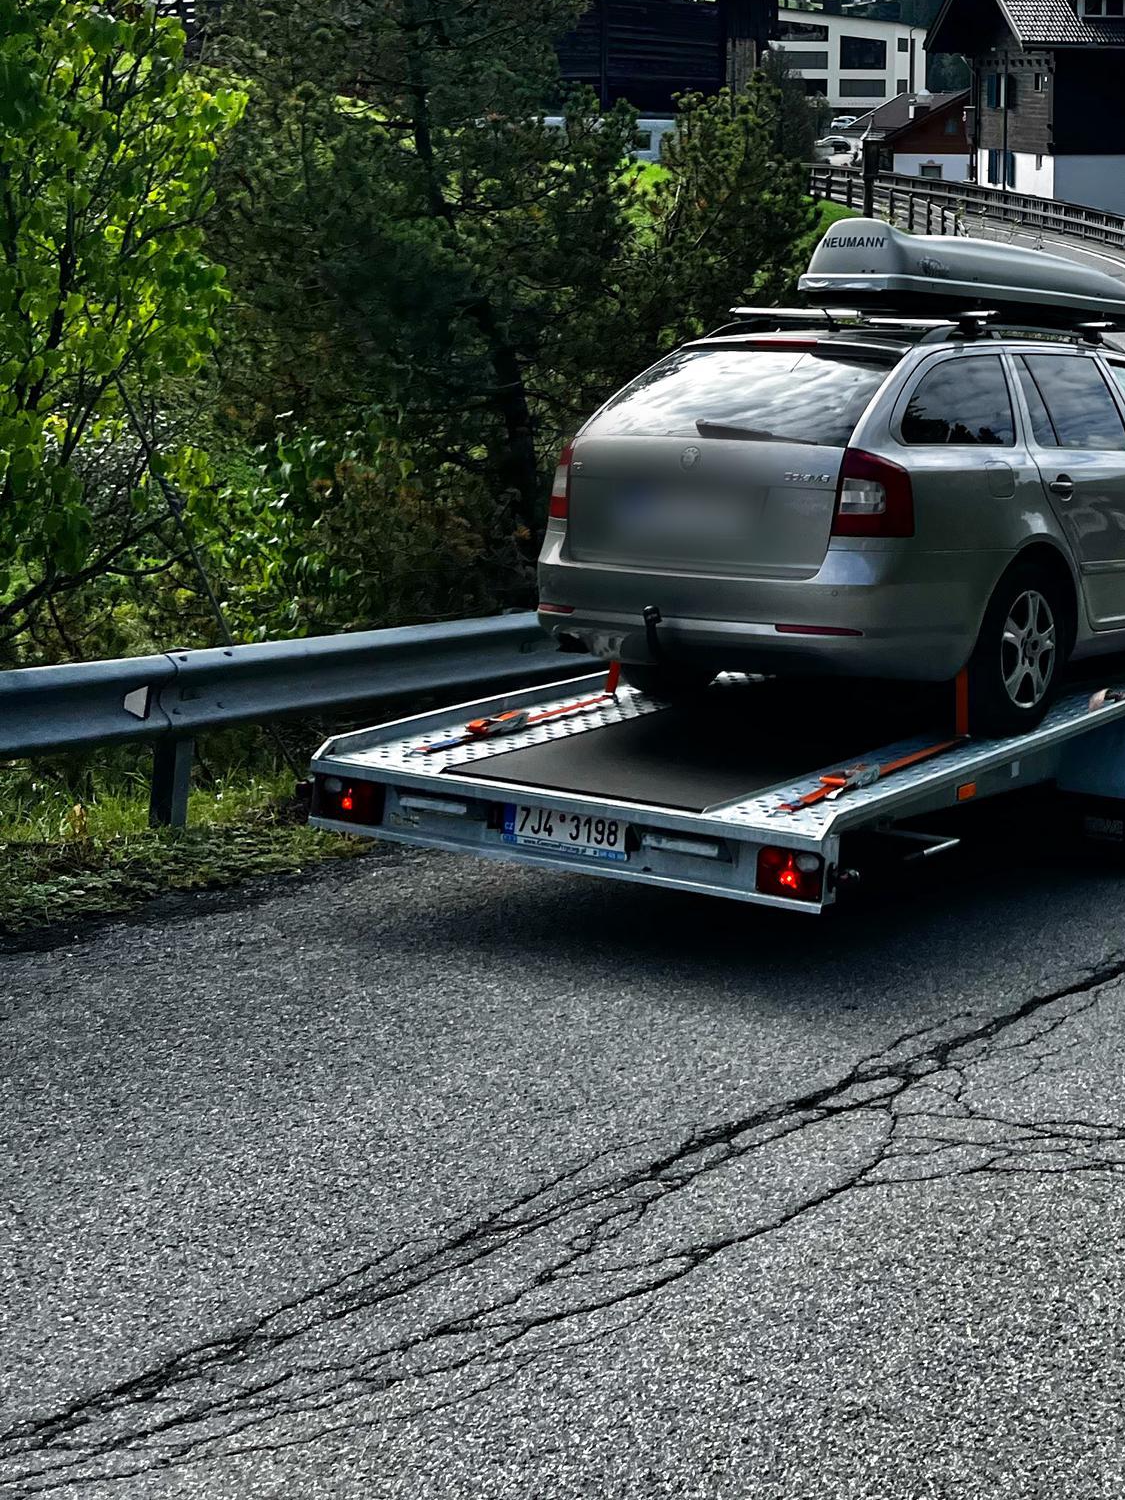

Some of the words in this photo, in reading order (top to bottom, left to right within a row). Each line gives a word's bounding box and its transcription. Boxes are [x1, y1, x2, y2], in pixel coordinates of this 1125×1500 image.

[822, 236, 885, 248] NEUMANN
[518, 806, 553, 837] 7J4
[569, 815, 619, 847] 3198
